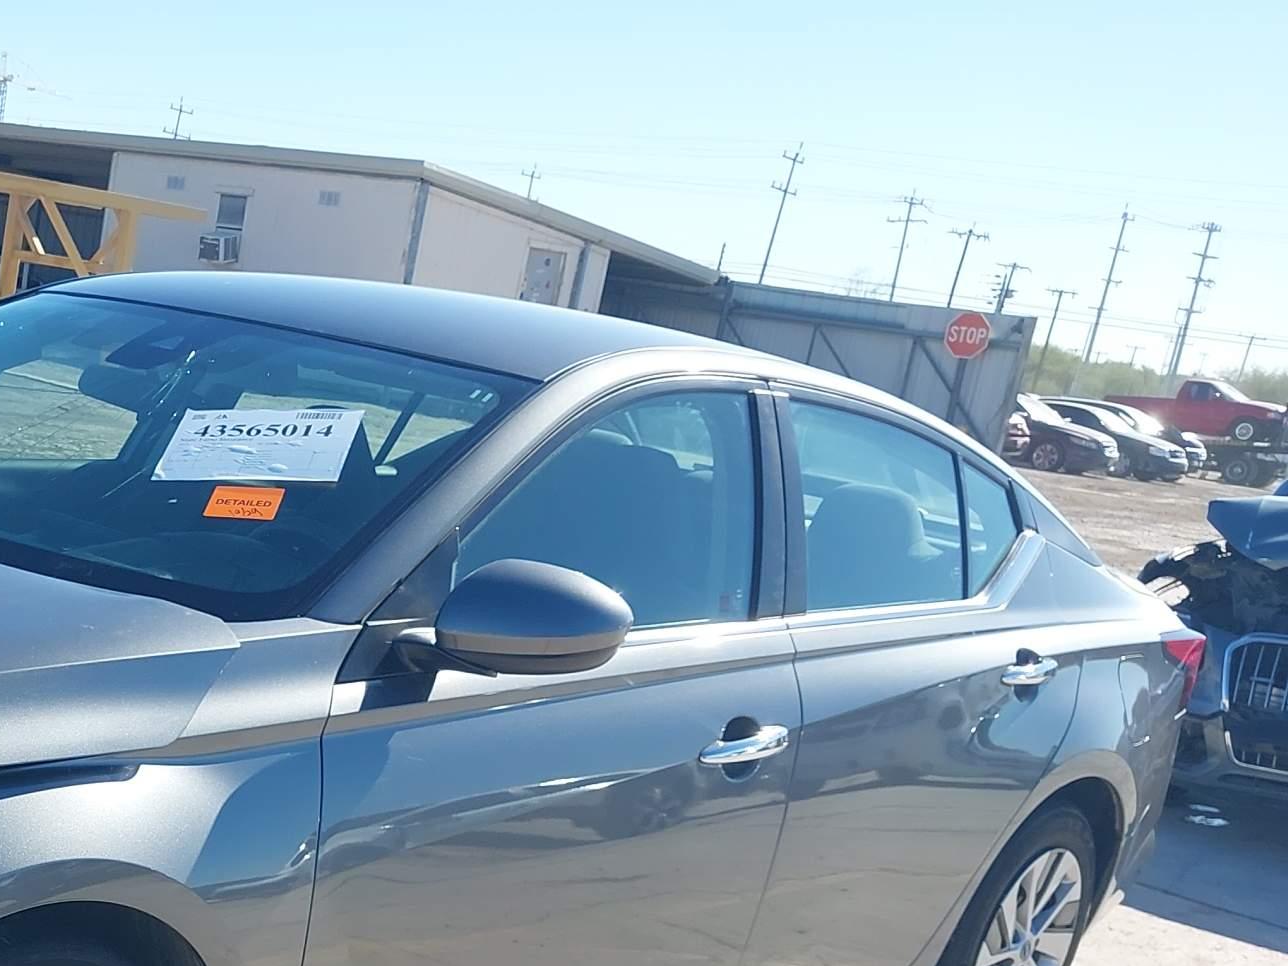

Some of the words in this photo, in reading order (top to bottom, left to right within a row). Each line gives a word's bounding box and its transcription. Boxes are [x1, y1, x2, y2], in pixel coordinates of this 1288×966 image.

[948, 325, 987, 345] STOP
[193, 423, 334, 437] 43565014
[215, 498, 272, 507] DETAILED
